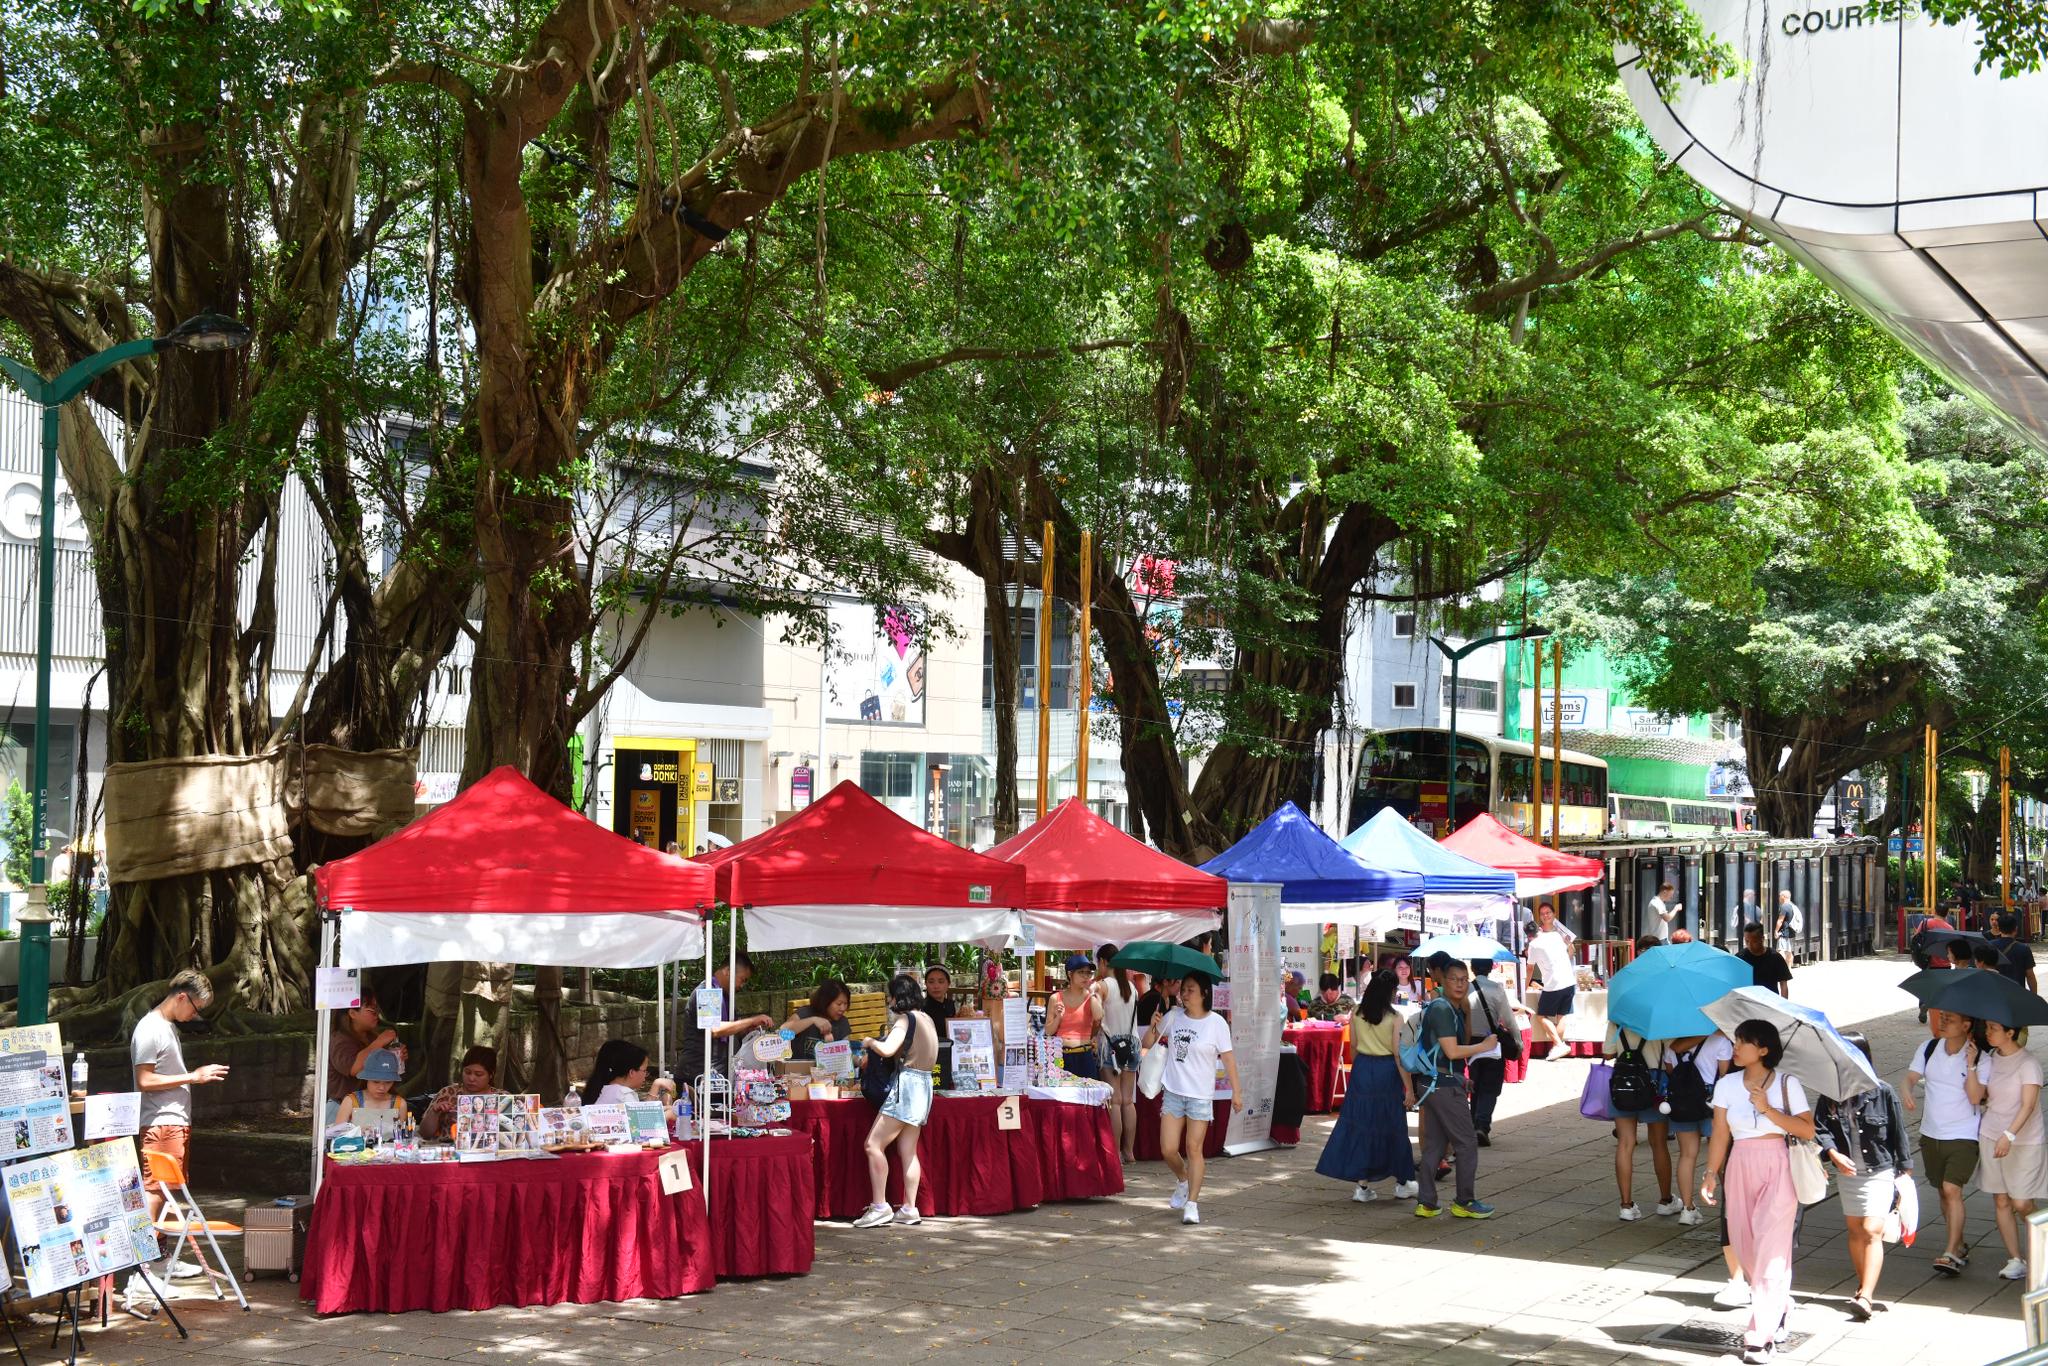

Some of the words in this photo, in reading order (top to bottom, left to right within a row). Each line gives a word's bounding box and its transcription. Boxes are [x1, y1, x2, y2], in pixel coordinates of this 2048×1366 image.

[1544, 707, 1575, 721] talor
[653, 770, 678, 781] DONKI
[1004, 1106, 1014, 1120] 3
[670, 1163, 680, 1180] 1
